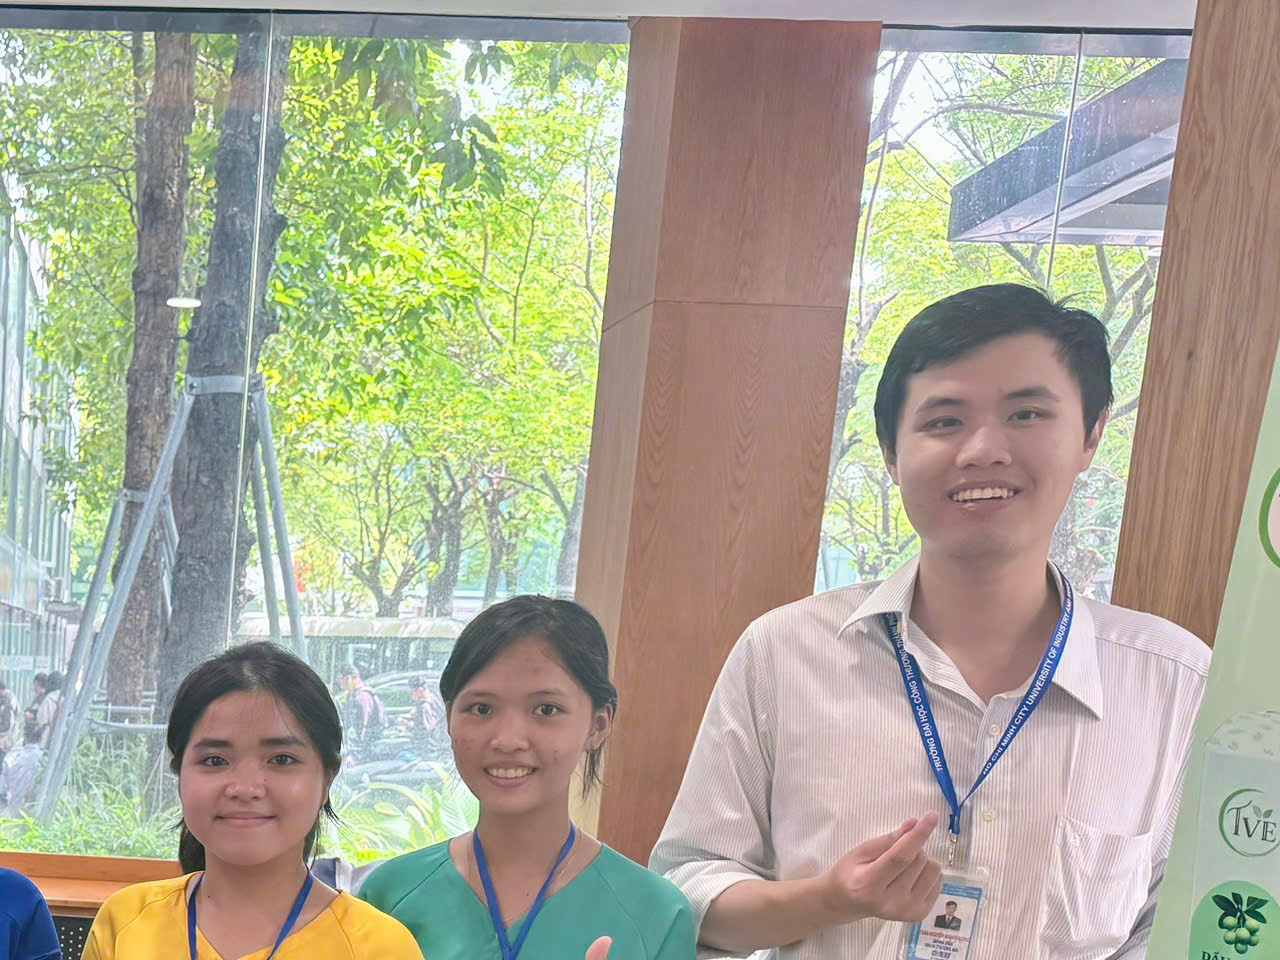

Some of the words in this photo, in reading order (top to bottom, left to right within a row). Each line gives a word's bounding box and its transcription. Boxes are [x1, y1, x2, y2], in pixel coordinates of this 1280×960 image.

[1001, 725, 1017, 748] MINH
[1014, 705, 1030, 725] CITY
[1026, 658, 1054, 706] UNIVERSITY
[1048, 645, 1058, 659] OF
[1053, 611, 1071, 648] INDUSTRY
[1226, 800, 1279, 844] TVE
